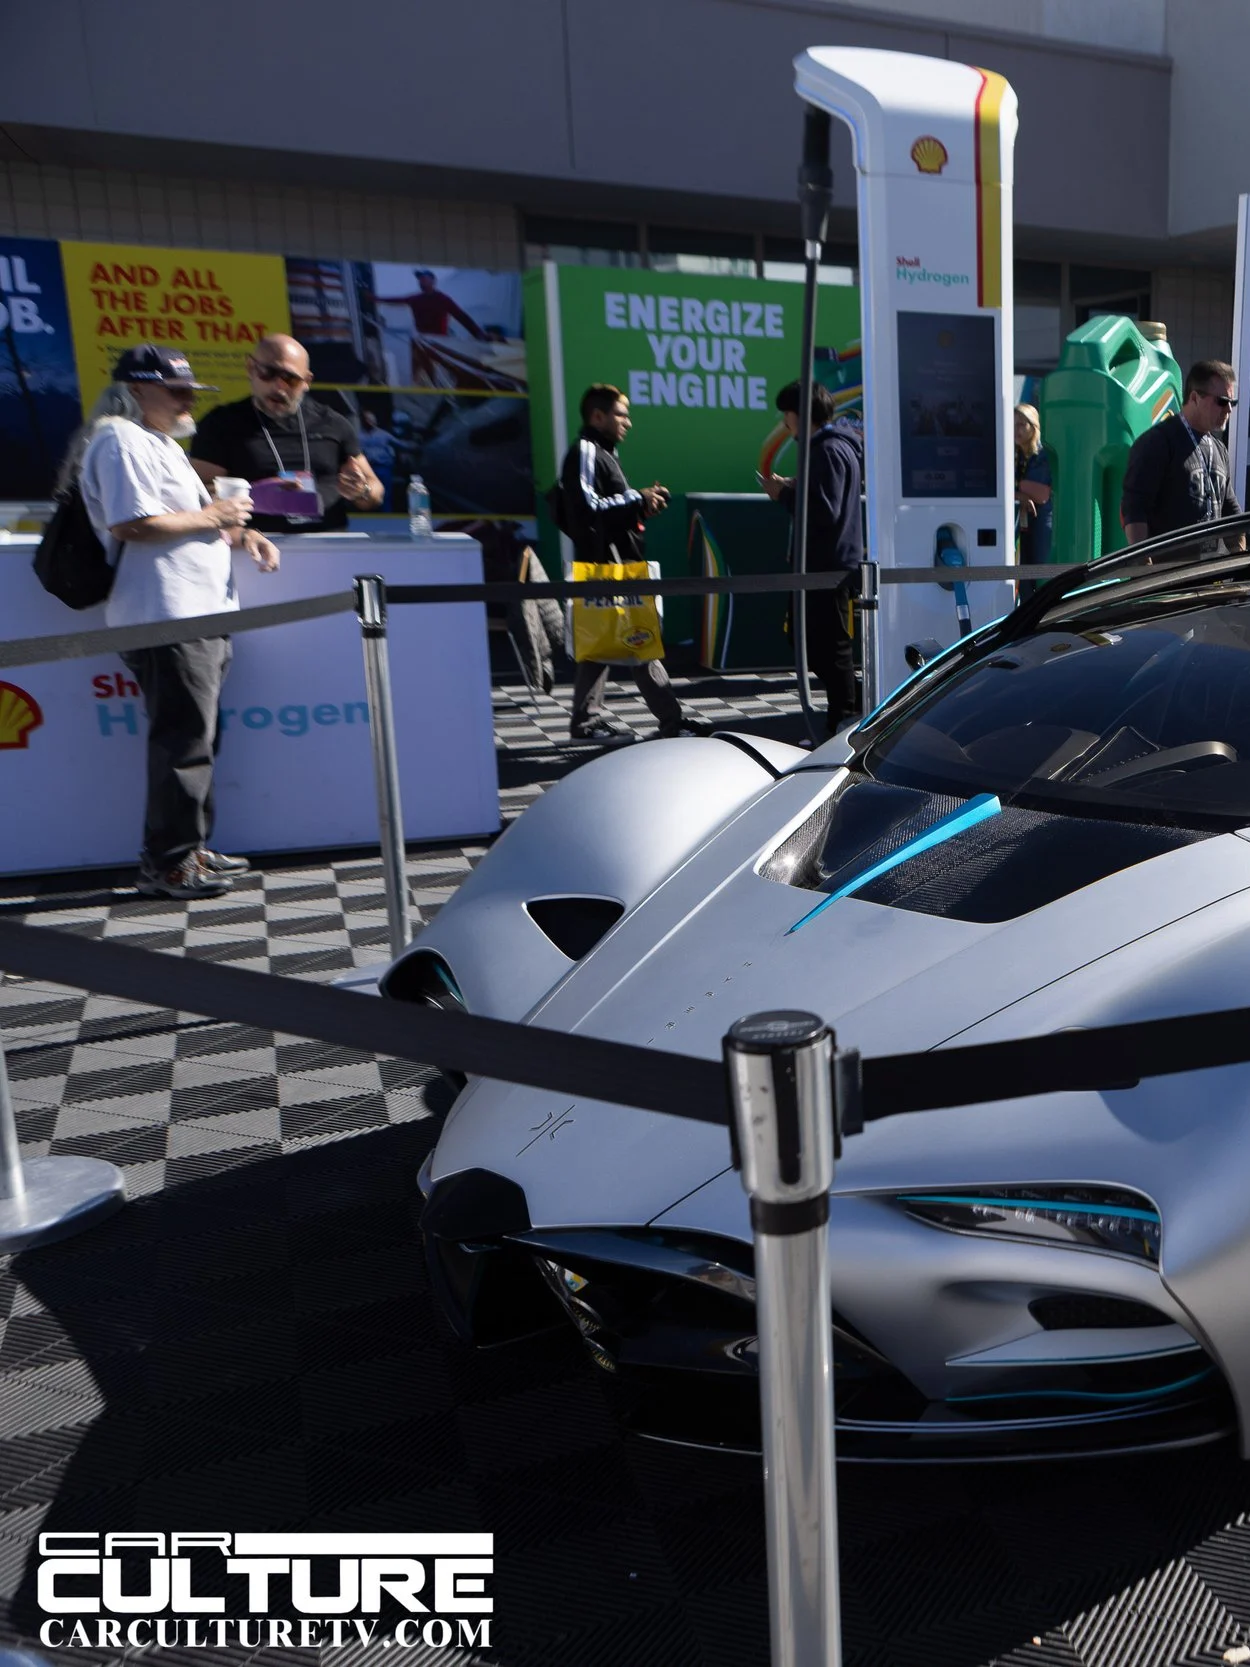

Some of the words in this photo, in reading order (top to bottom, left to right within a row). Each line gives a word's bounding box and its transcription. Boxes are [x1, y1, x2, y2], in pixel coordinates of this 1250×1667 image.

[90, 262, 161, 288] AND
[171, 267, 223, 292] ALL
[896, 256, 921, 268] Shell
[896, 268, 970, 287] Hydrogen
[90, 287, 149, 313] THE
[158, 293, 235, 318] JOBS
[604, 291, 785, 338] ENERGIZE
[96, 315, 189, 342] AFTER
[195, 321, 269, 344] THAT
[647, 333, 747, 373] YOUR
[628, 370, 768, 411] ENGINE
[96, 701, 371, 736] Hrogen
